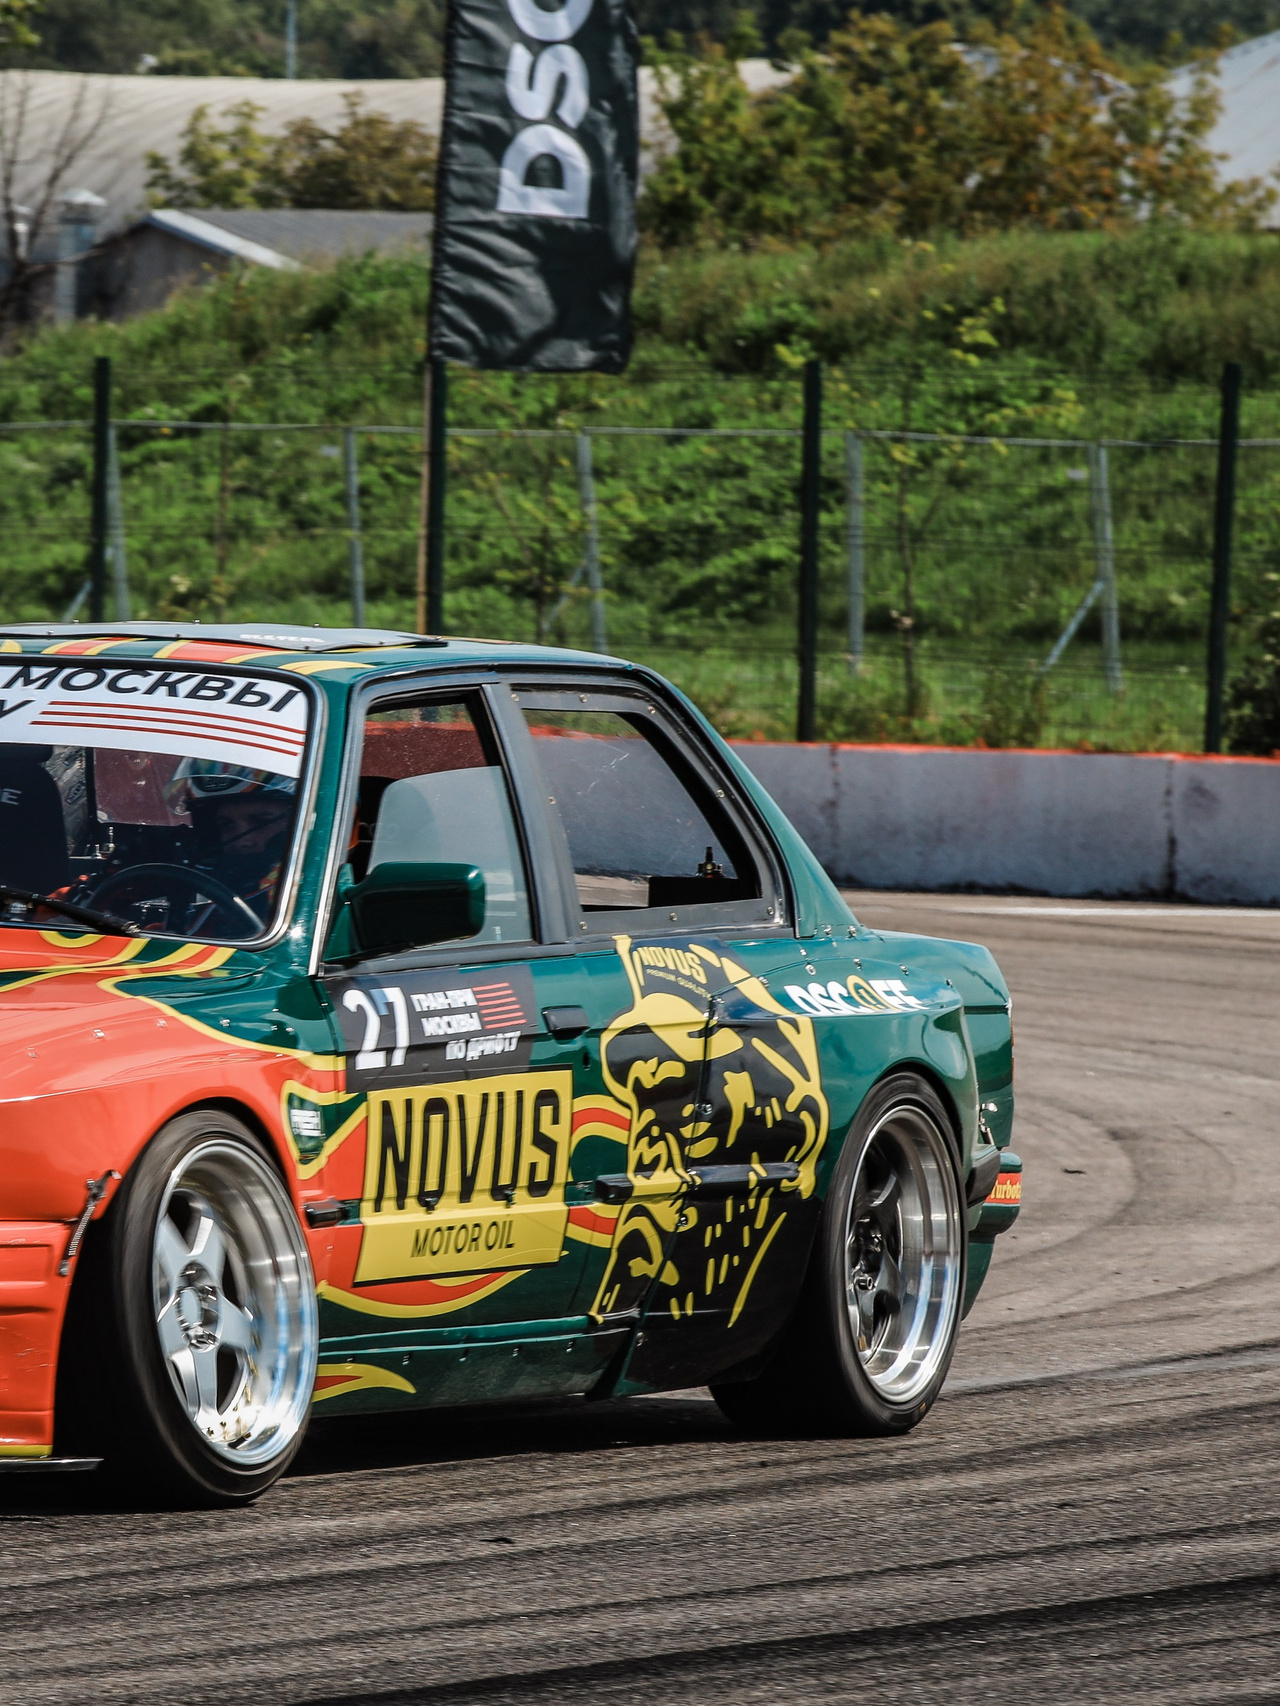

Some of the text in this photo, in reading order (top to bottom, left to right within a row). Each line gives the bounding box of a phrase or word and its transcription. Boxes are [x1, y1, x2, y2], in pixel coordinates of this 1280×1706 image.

[2, 666, 303, 712] МОСКВЫ
[637, 946, 708, 984] NOVUS
[410, 988, 478, 1012] ГРАН-ПРИ
[342, 986, 410, 1070] 27
[421, 1012, 482, 1037] МОСКВЫ
[446, 1030, 521, 1061] ПО ДРИФТУ
[374, 1089, 560, 1213] NOVUS
[410, 1220, 516, 1258] MOTOR OIL
